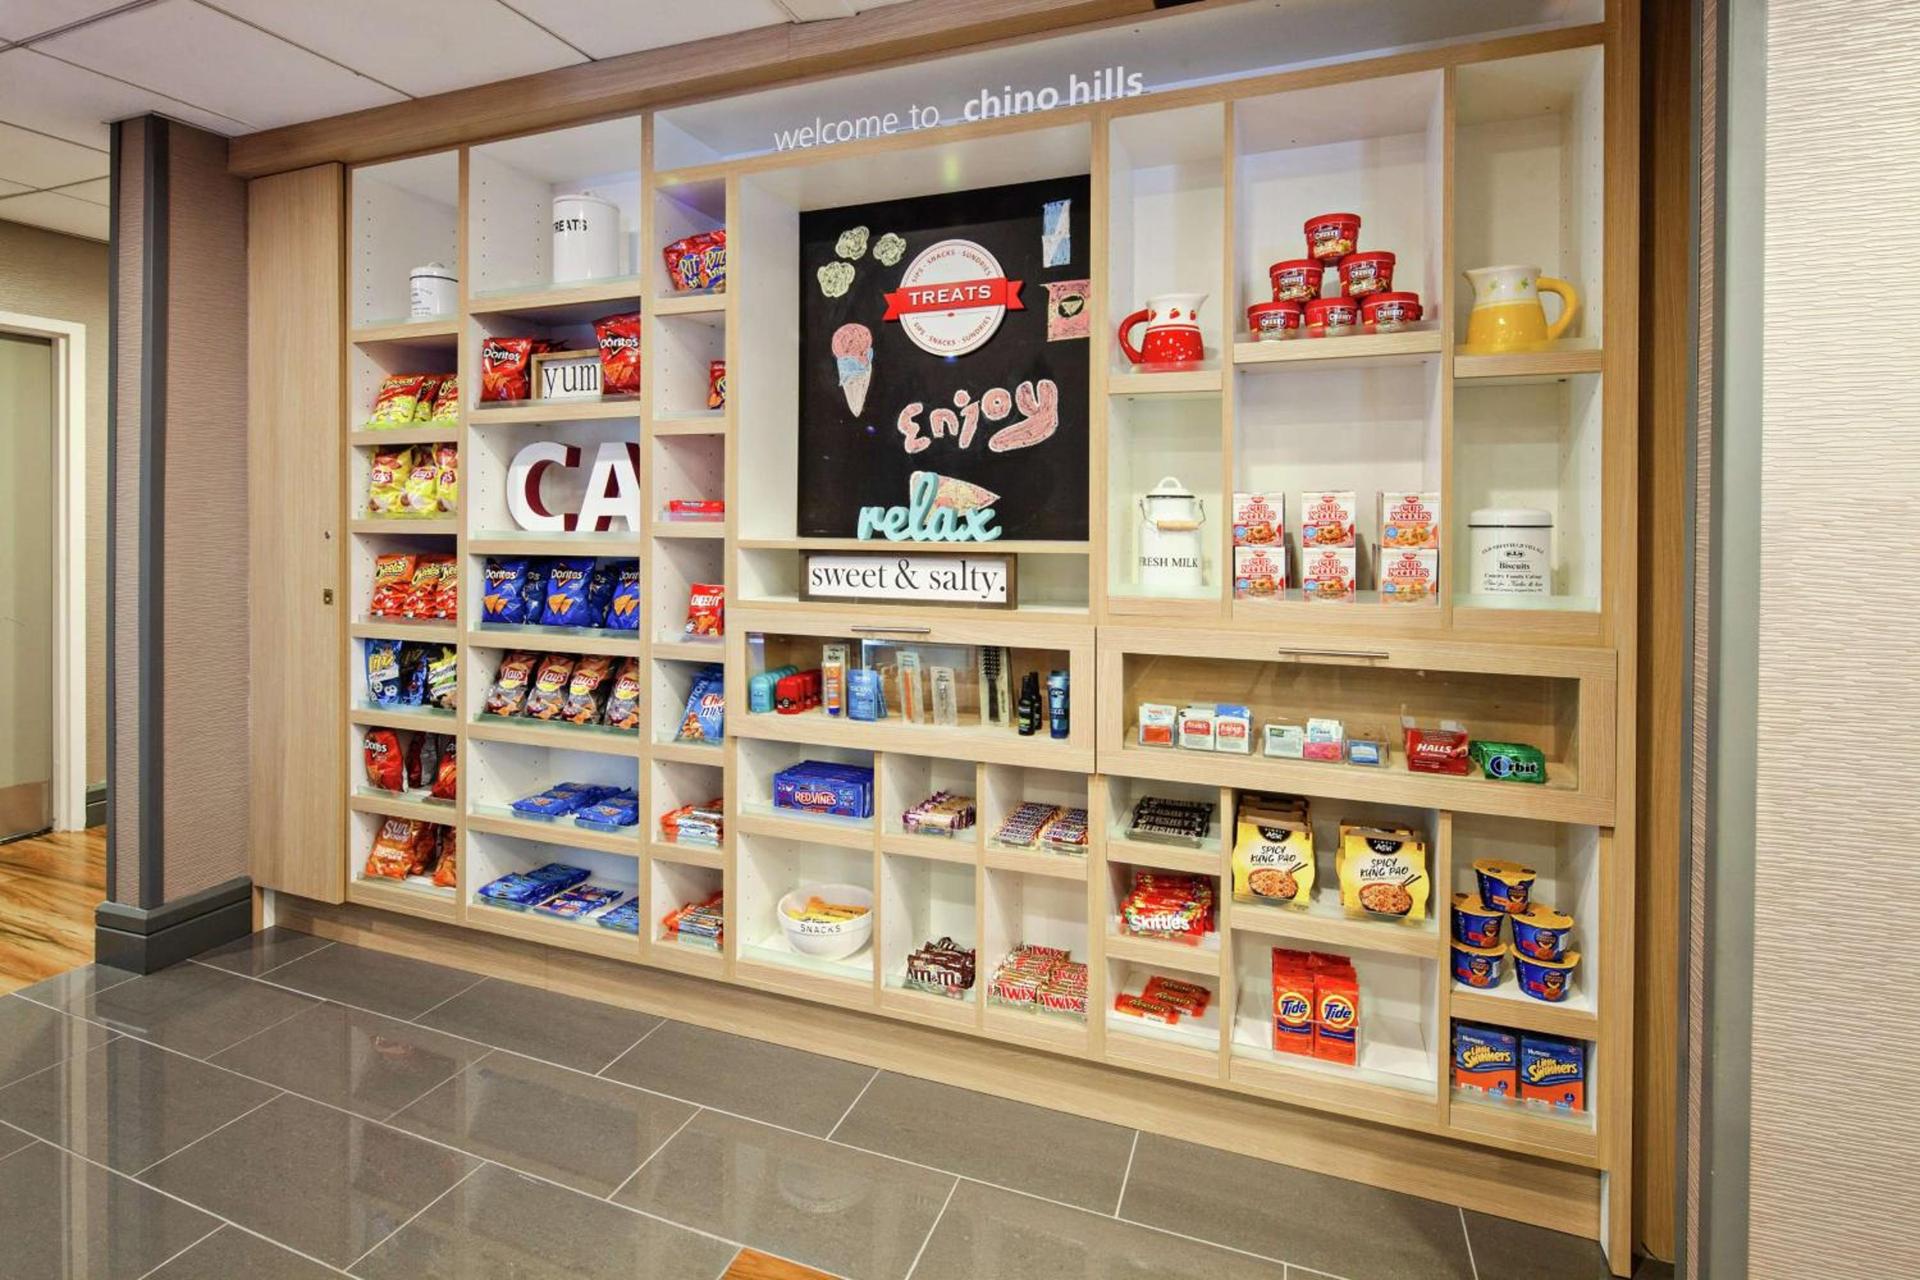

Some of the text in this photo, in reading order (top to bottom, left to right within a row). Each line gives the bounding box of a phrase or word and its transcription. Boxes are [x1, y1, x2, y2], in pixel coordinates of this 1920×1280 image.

[773, 66, 1144, 152] welcome to chino hills
[908, 285, 992, 306] TREATS
[483, 348, 521, 362] Doritos
[544, 364, 598, 400] yum
[897, 378, 1060, 454] Enjoy
[857, 470, 1003, 541] relax
[1172, 557, 1199, 568] MILK
[1499, 561, 1530, 570] Biscuits
[486, 568, 516, 579] Doritos
[551, 568, 583, 579] Doritos
[811, 557, 1006, 599] sweet & salty.
[1416, 743, 1453, 753] HALLS
[1488, 755, 1538, 777] Orbit
[794, 791, 811, 804] RED
[810, 791, 837, 806] VINES
[1261, 845, 1287, 855] SPICY
[1250, 854, 1297, 864] KUNG PAO
[1371, 858, 1398, 868] SPICY
[1360, 867, 1409, 878] KUNG PAO
[800, 923, 841, 934] SNACKS
[1280, 1000, 1308, 1016] Tide
[1324, 1003, 1352, 1020] Tide
